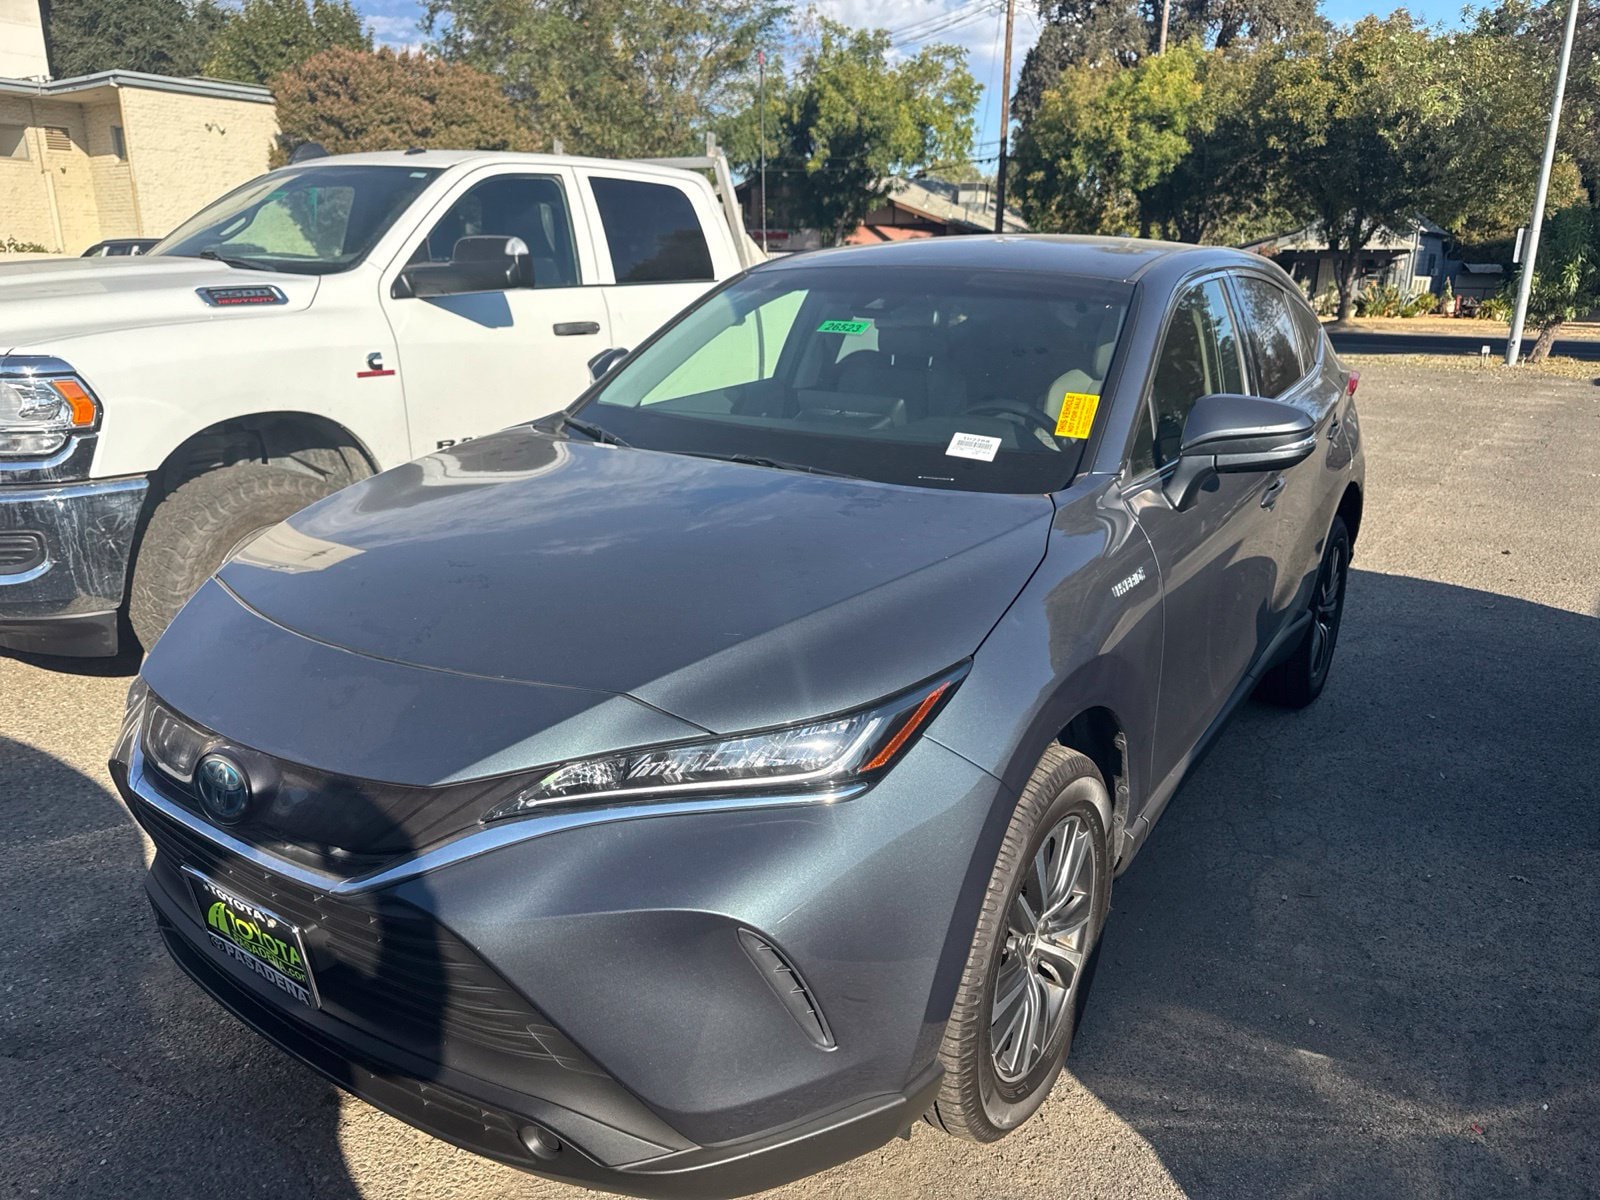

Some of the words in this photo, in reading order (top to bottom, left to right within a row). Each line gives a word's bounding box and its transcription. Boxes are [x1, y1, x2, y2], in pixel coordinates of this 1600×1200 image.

[824, 323, 862, 332] 26523
[207, 883, 266, 923] TOYOTA
[225, 909, 302, 965] TOYOTA
[224, 941, 310, 1006] PASADENA
